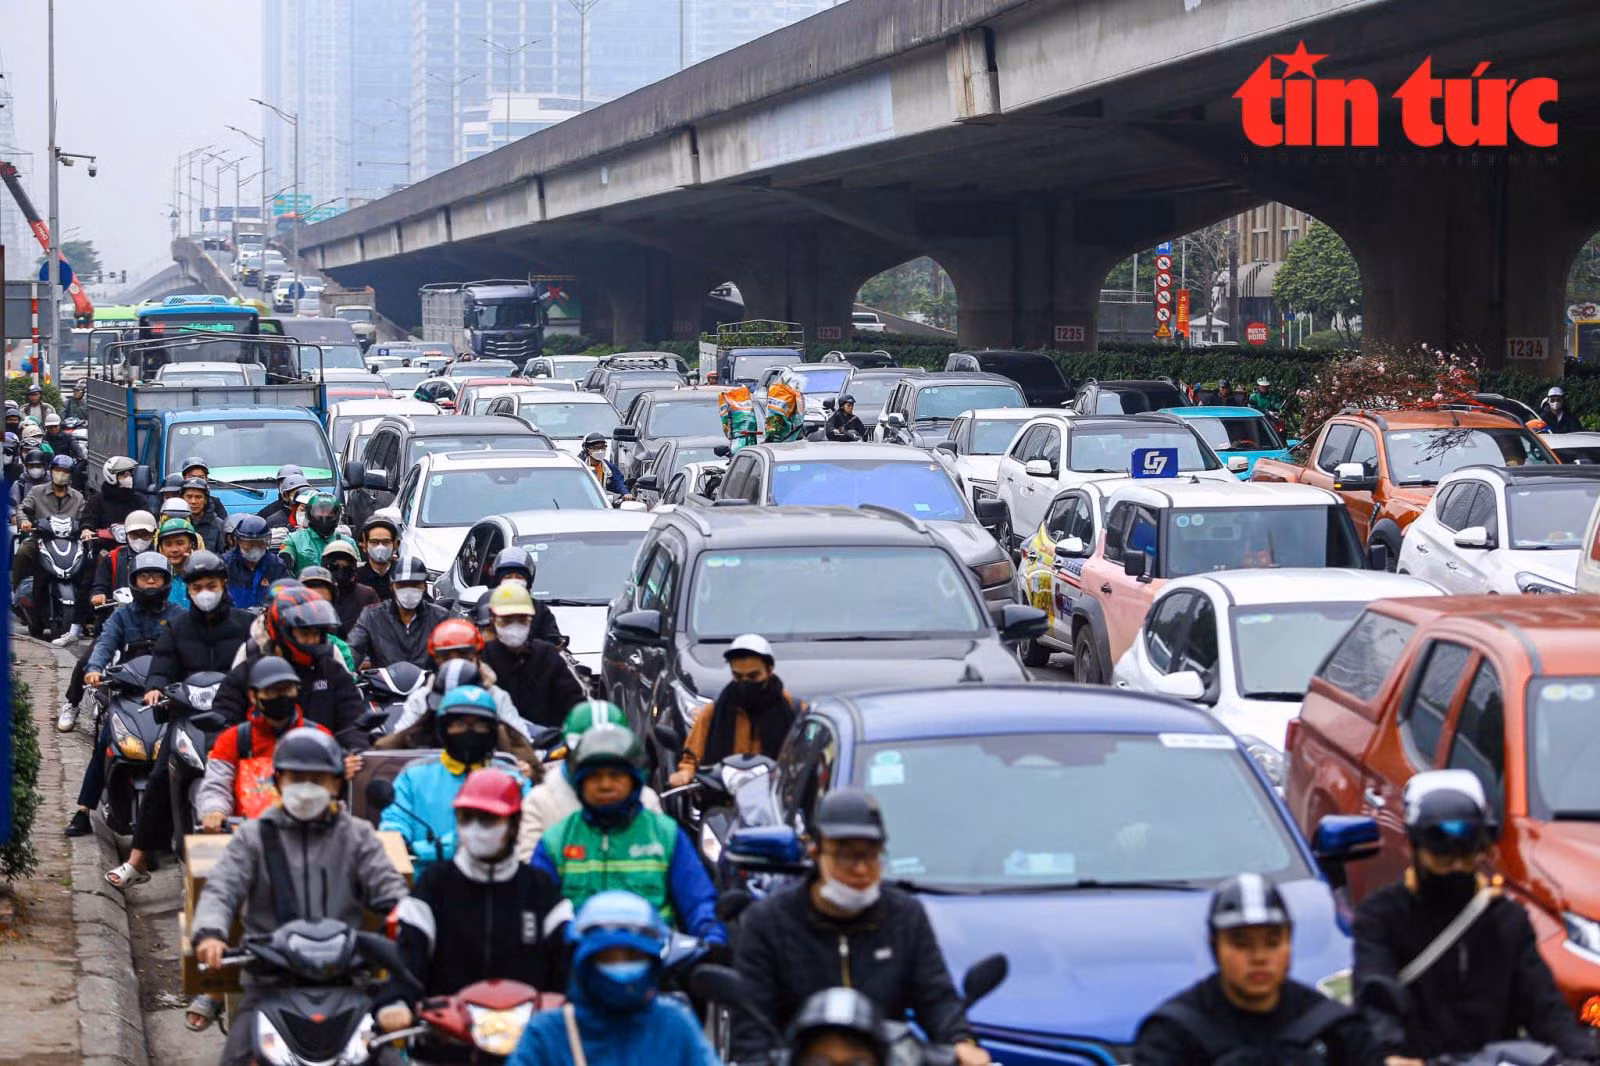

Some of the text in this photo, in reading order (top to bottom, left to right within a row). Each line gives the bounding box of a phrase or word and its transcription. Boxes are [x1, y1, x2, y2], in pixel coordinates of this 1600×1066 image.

[36, 223, 48, 240] UNIC
[1057, 328, 1082, 340] T235
[1509, 340, 1543, 357] T234
[1144, 451, 1168, 475] G7
